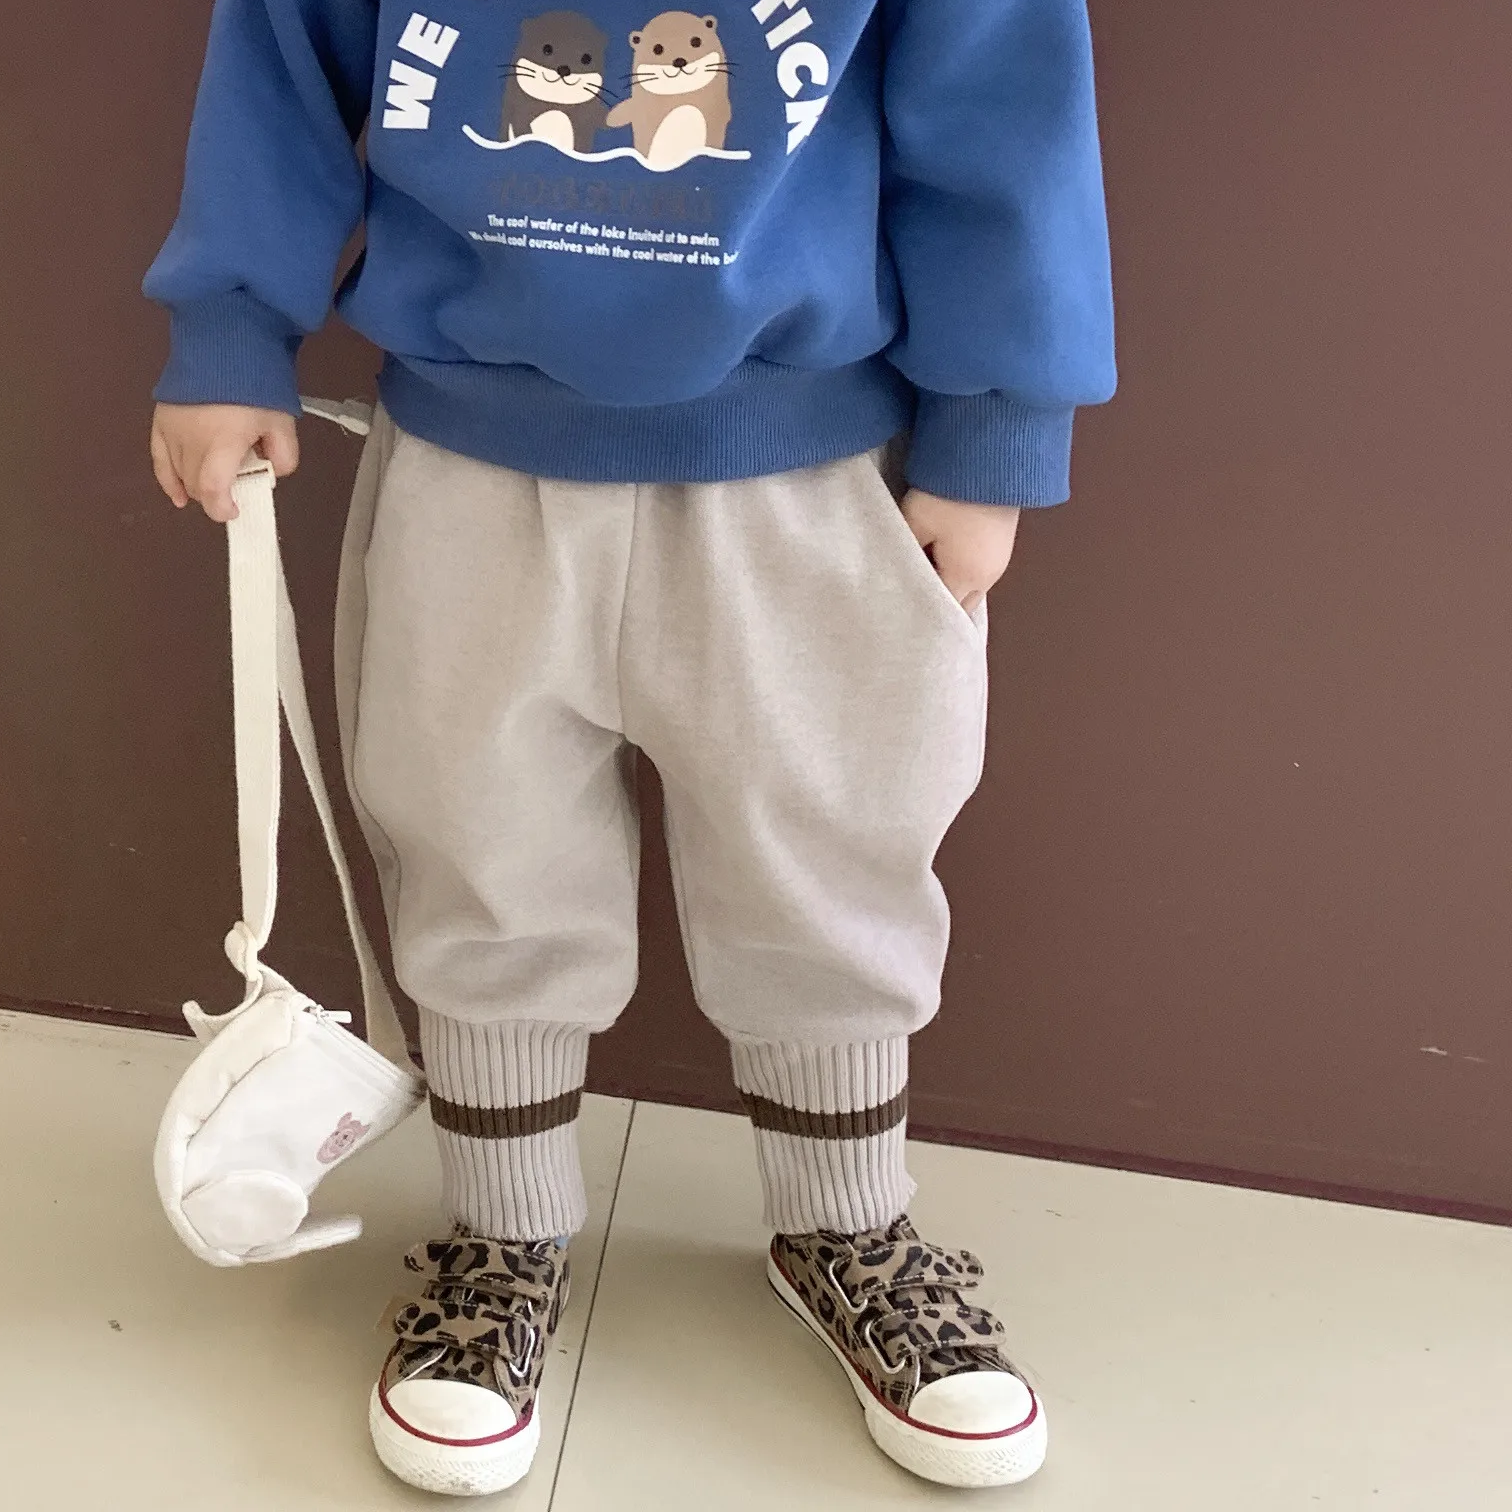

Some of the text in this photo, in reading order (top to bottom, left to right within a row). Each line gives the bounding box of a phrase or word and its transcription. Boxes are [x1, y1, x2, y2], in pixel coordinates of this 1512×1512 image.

[383, 13, 460, 131] WE
[488, 214, 505, 228] The
[507, 215, 528, 229] cool
[565, 220, 579, 234] of
[580, 222, 600, 238] the
[677, 232, 689, 245] to
[507, 233, 526, 247] cool
[585, 242, 609, 257] with
[611, 244, 631, 260] the
[633, 247, 654, 262] cool
[686, 250, 699, 265] of
[700, 252, 720, 266] the
